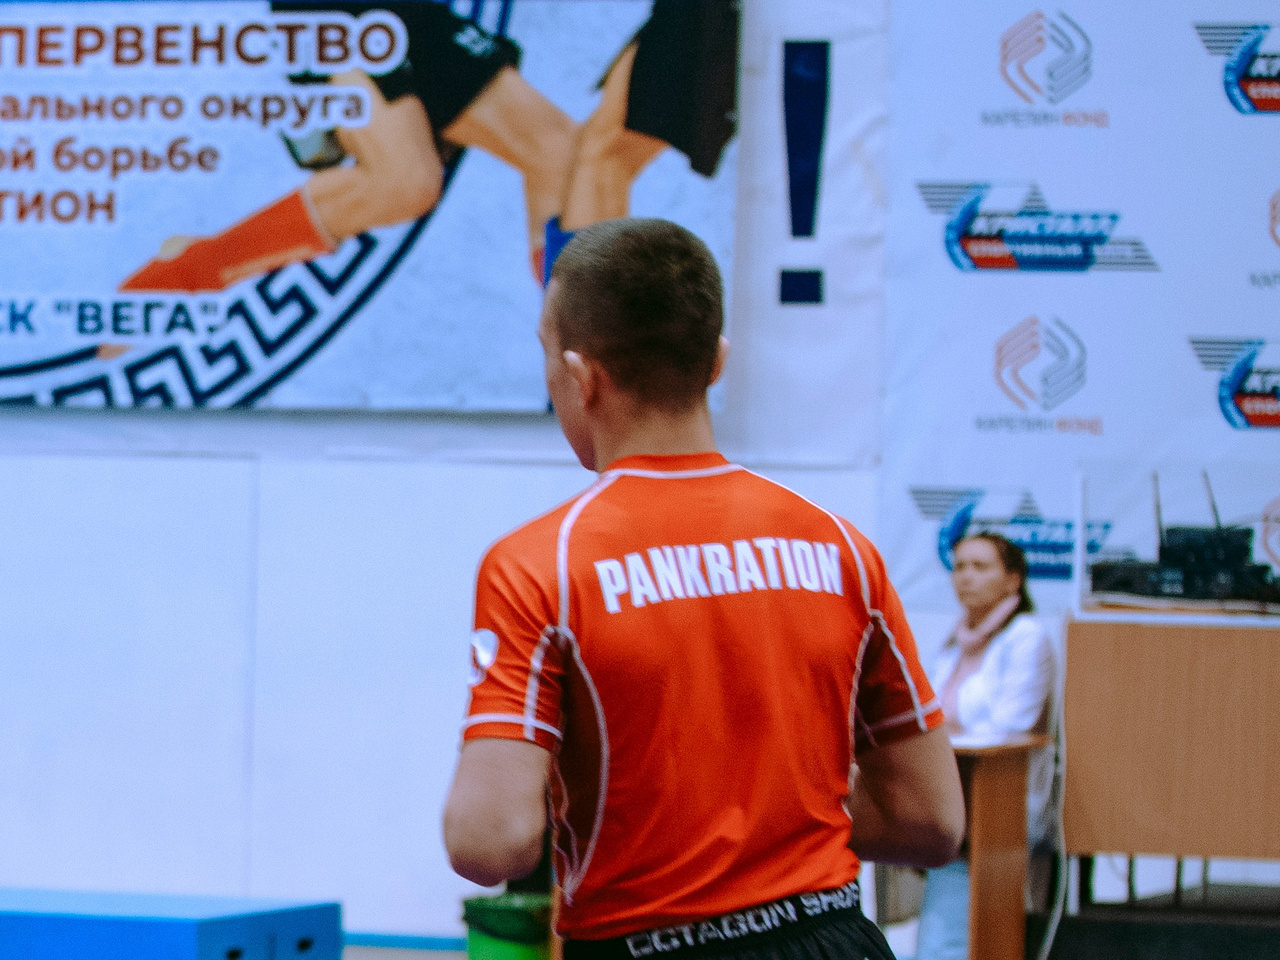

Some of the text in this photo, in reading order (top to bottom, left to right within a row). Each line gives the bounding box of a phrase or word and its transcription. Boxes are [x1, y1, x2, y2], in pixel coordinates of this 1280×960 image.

[200, 84, 364, 127] округа
[53, 134, 219, 180] борьбе
[594, 536, 843, 614] PANKRATION
[625, 898, 799, 958] OCTAGON
